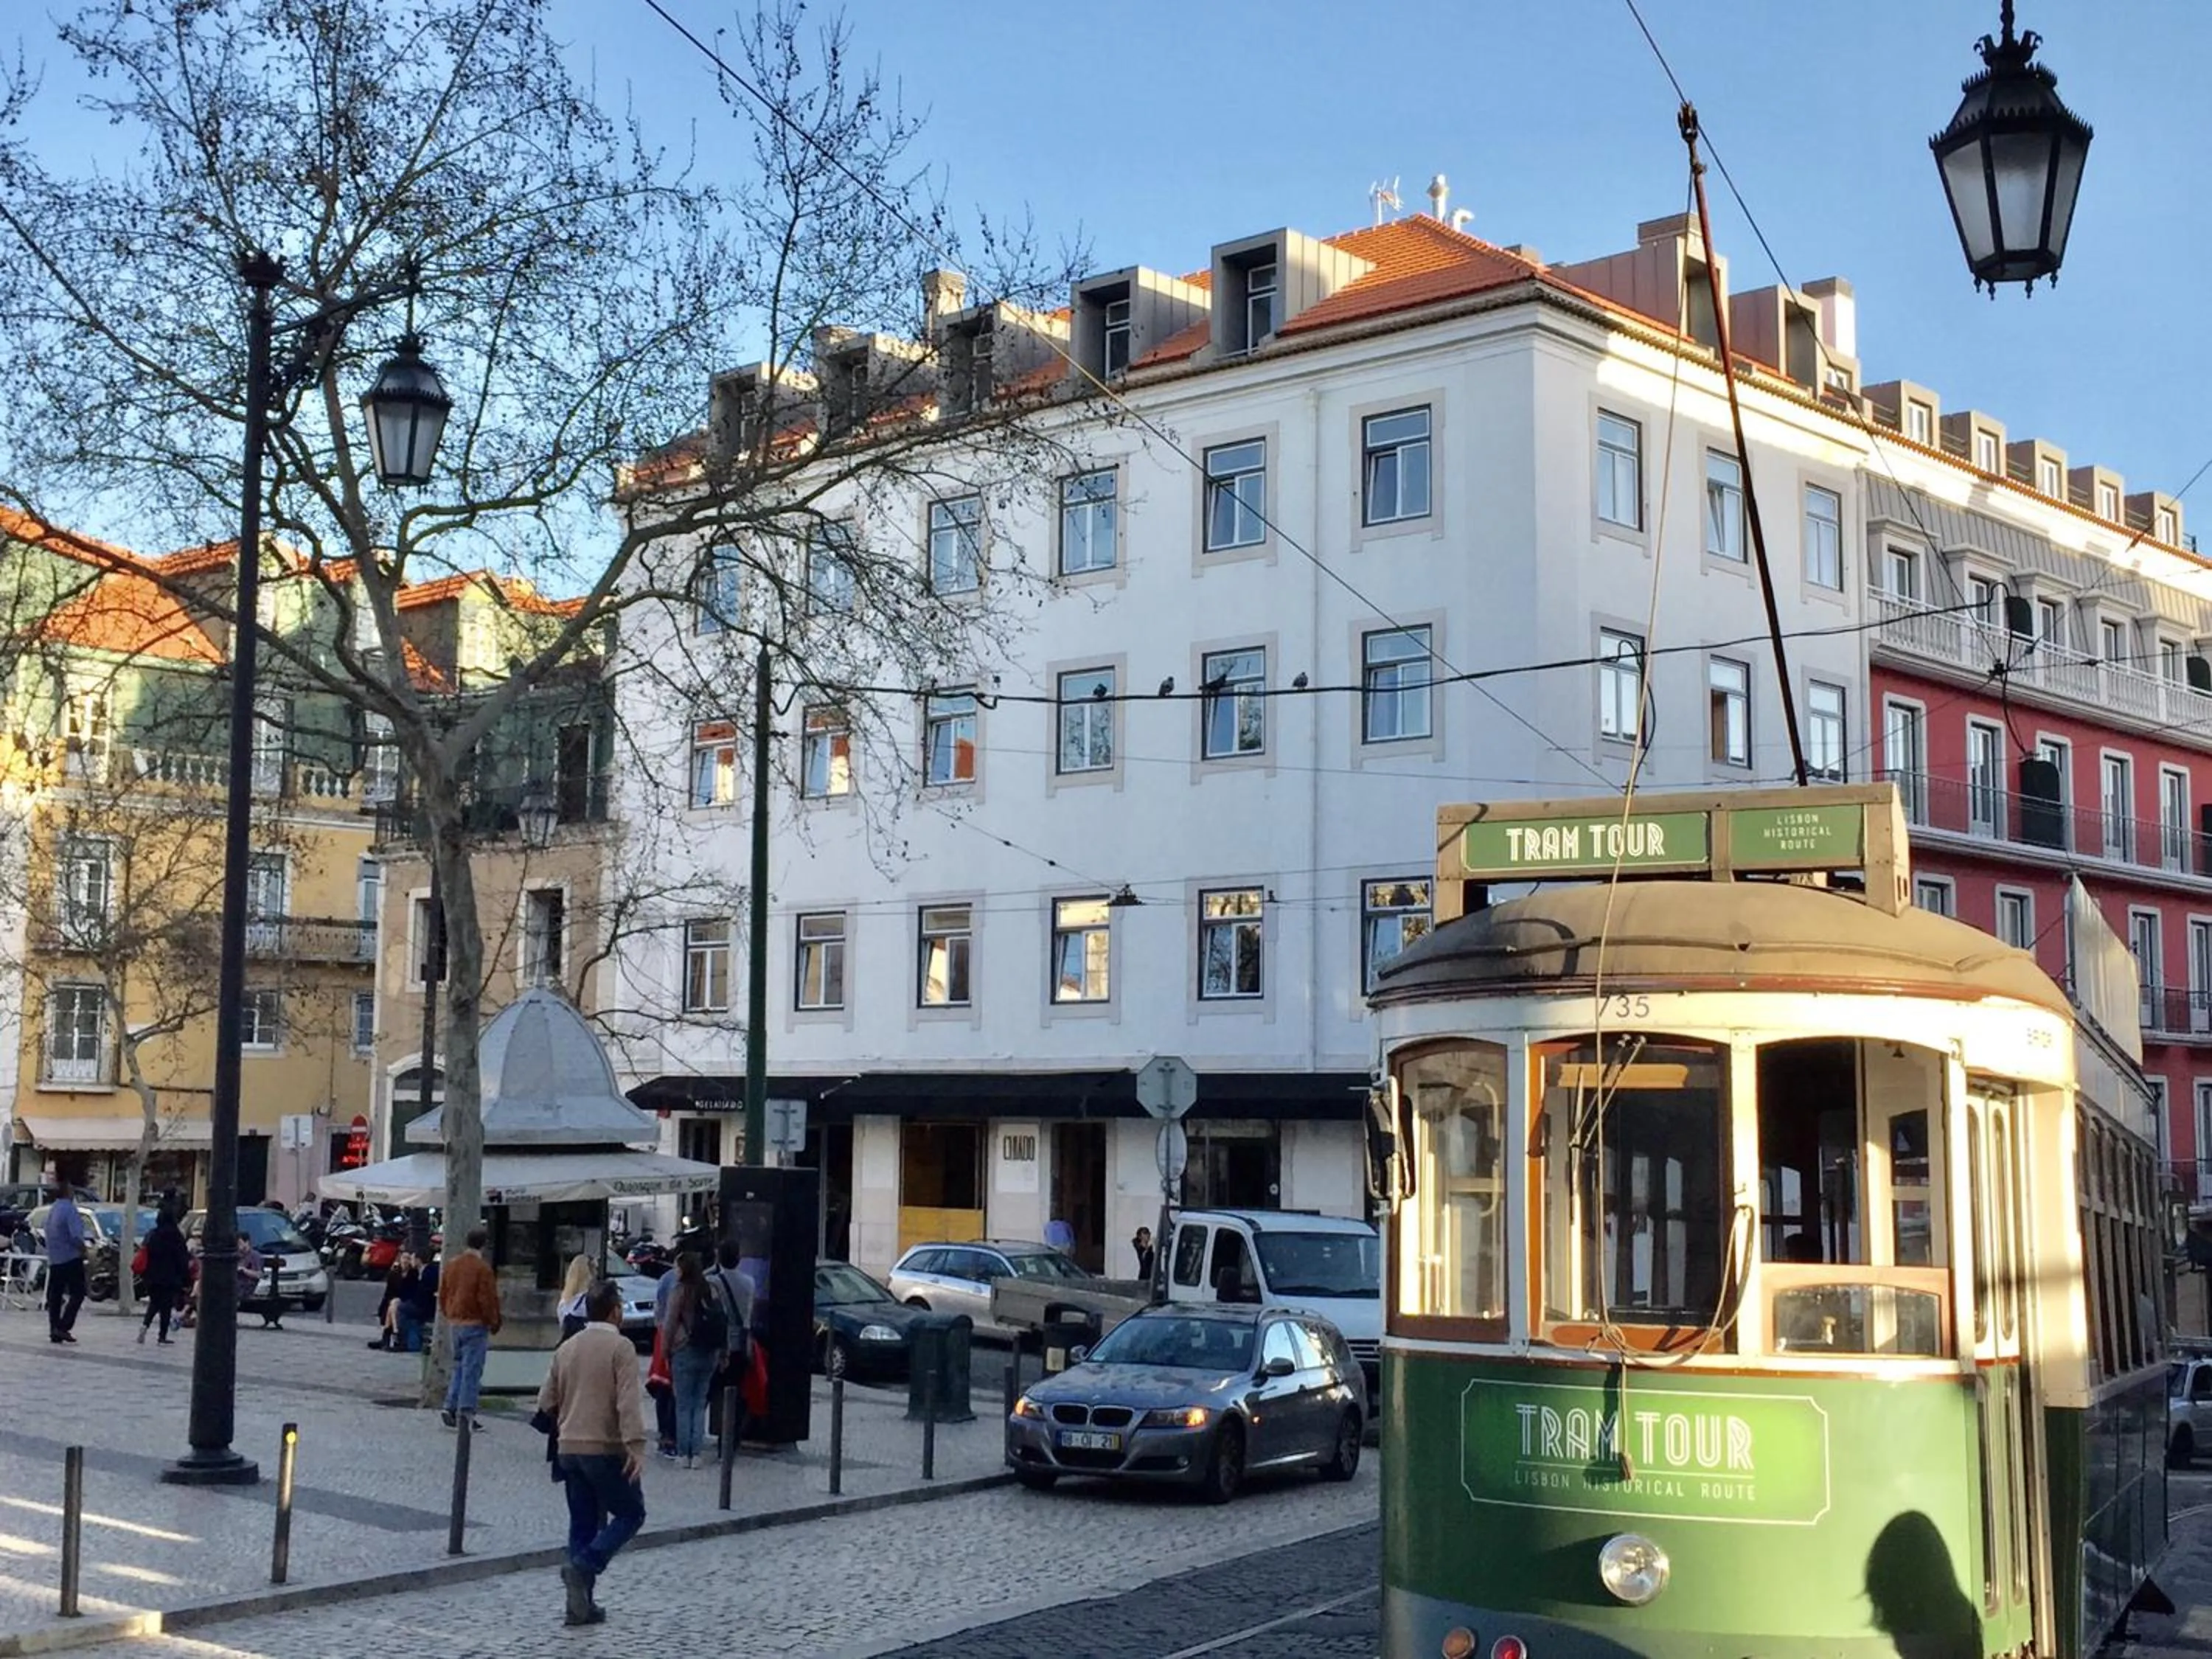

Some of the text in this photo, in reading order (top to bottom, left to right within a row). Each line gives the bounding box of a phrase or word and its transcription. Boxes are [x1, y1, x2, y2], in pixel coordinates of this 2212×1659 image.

[1776, 813, 1819, 825] LISBON
[1505, 821, 1666, 861] TRAM TOUR
[1763, 826, 1832, 838] HISTORICAL
[1780, 838, 1815, 849] ROUTE
[1598, 994, 1650, 1018] 735
[1515, 1403, 1756, 1470] TRAM TOUR
[1514, 1470, 1756, 1501] LISBON HISTORICAL ROUTE
